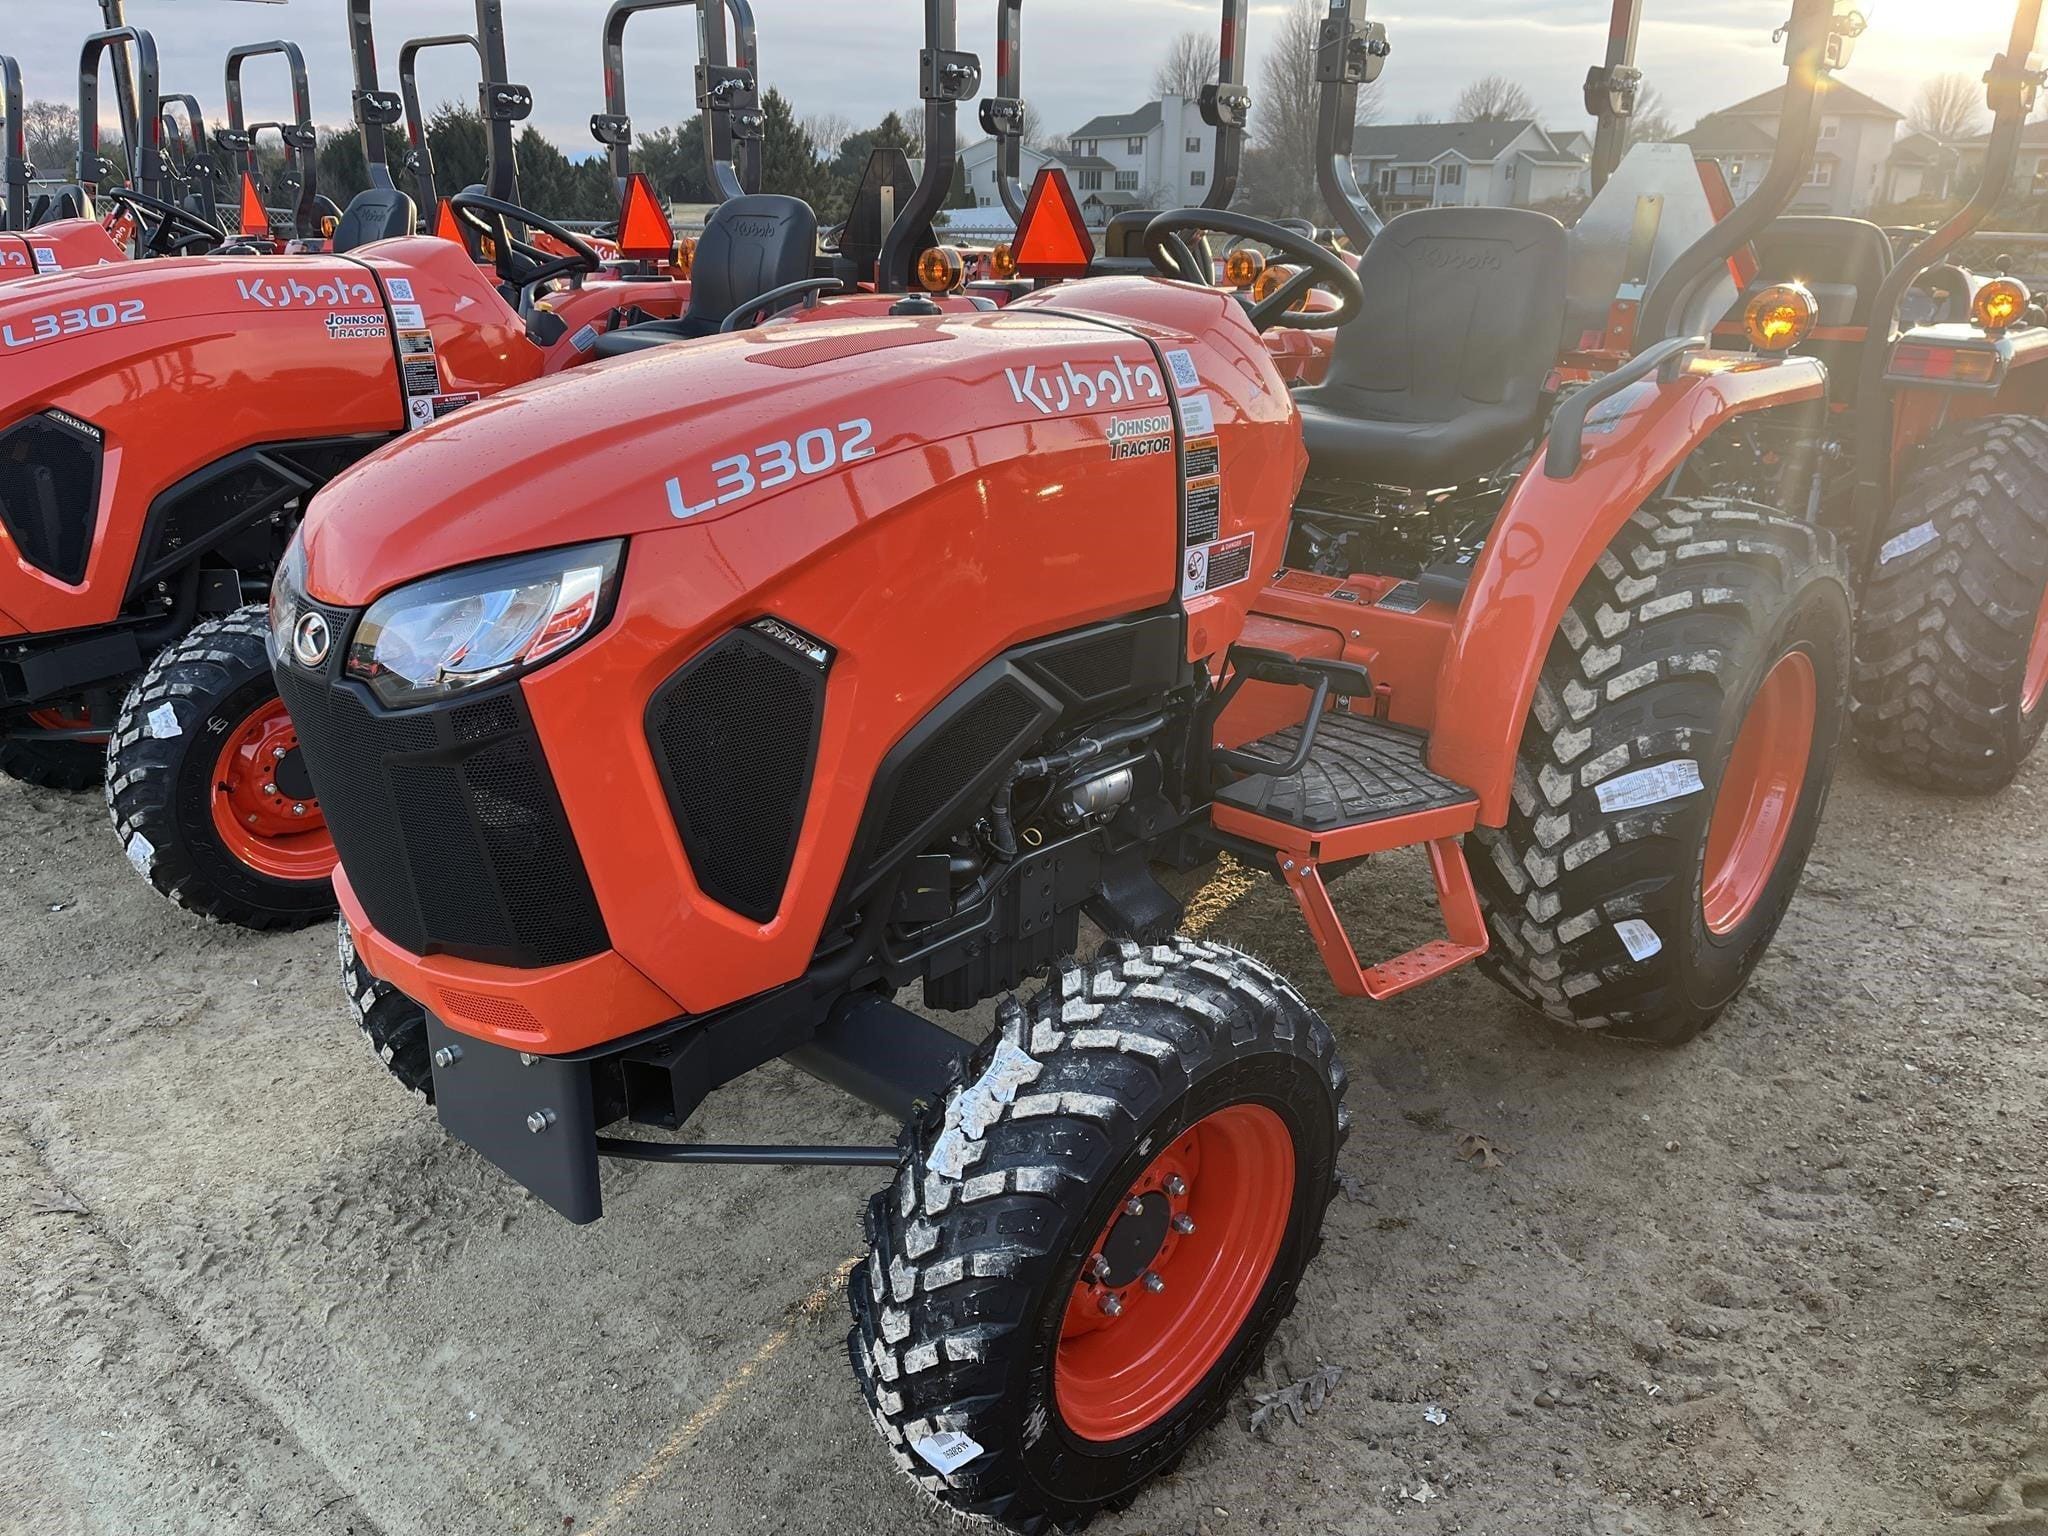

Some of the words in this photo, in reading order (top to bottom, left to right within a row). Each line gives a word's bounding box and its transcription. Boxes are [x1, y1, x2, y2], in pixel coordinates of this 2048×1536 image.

[237, 276, 376, 308] Kubota
[2, 299, 147, 348] L3302
[325, 313, 385, 326] JOHNSON
[328, 326, 387, 338] TRACTOR
[1004, 355, 1164, 414] Kubota
[1106, 416, 1170, 439] JOHNSON
[1110, 438, 1171, 460] TRACTOR
[665, 418, 876, 519] L3302
